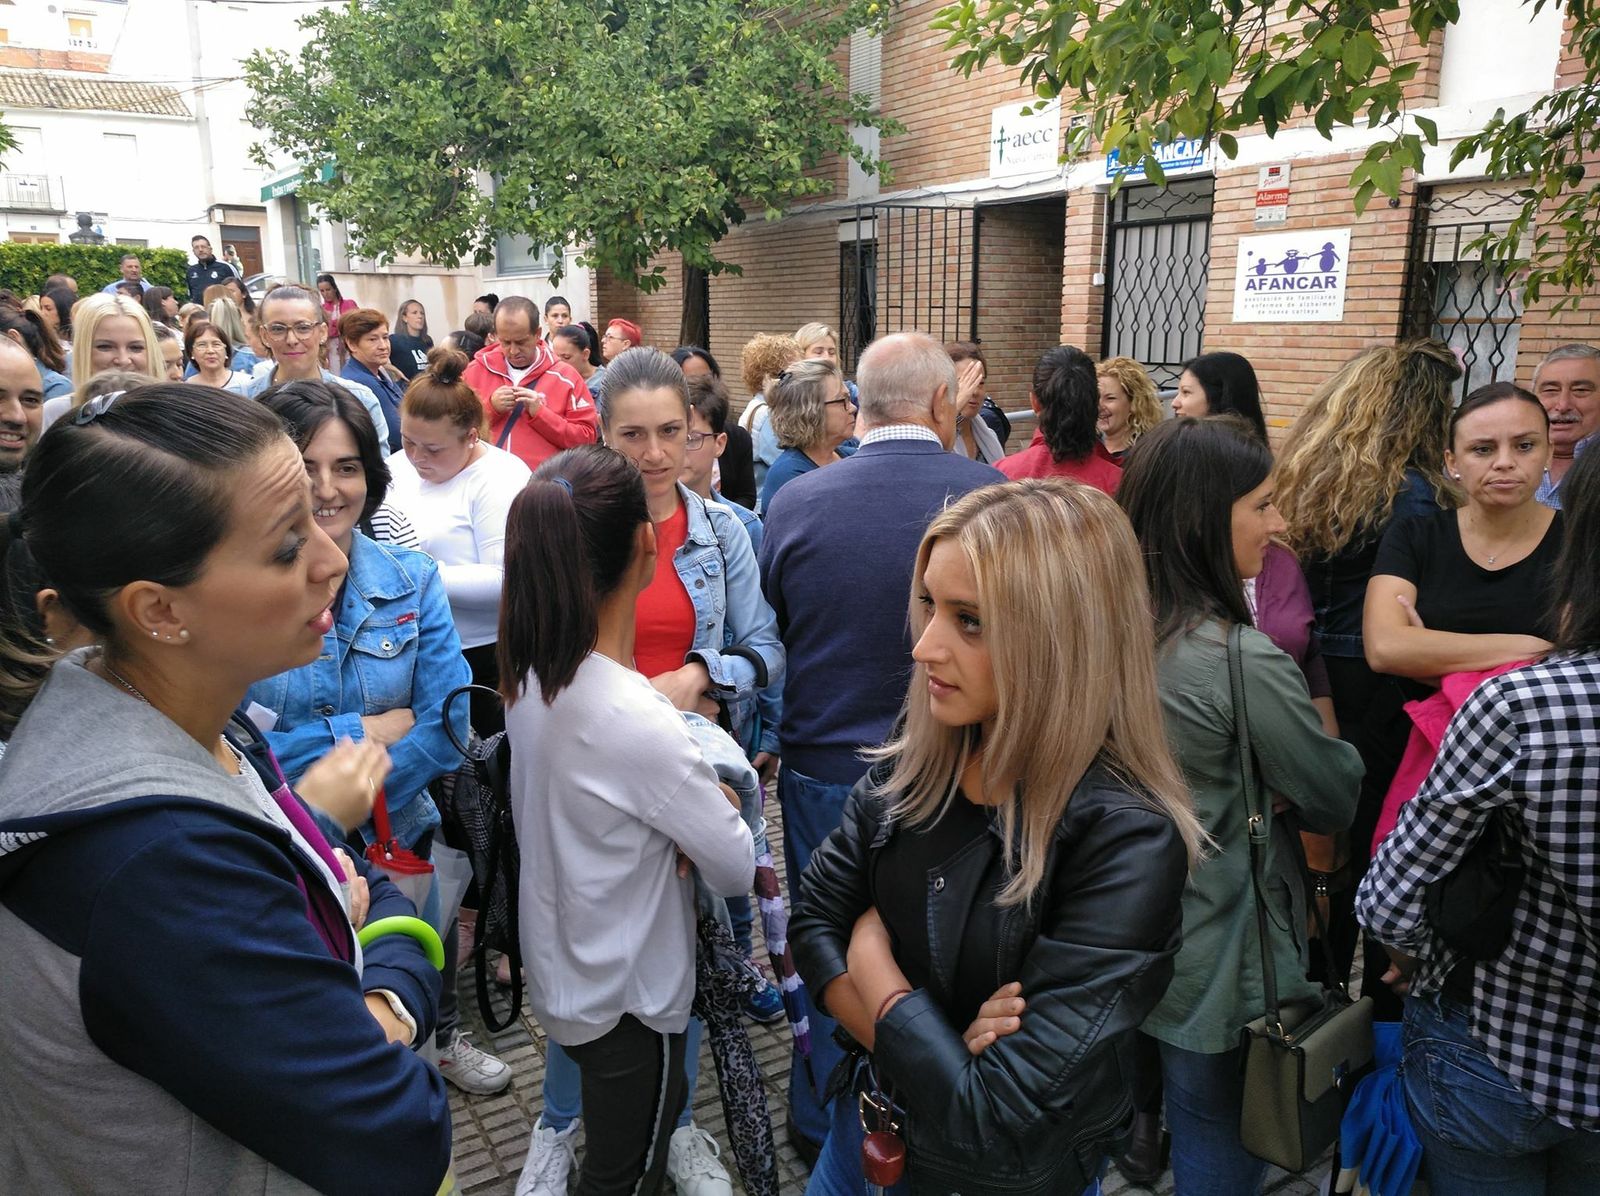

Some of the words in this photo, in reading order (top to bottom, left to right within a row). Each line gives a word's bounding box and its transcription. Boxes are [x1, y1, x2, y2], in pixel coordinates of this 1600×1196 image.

[1012, 127, 1053, 148] aecc
[1257, 191, 1288, 201] Alarma
[1245, 276, 1337, 291] AFANCAR
